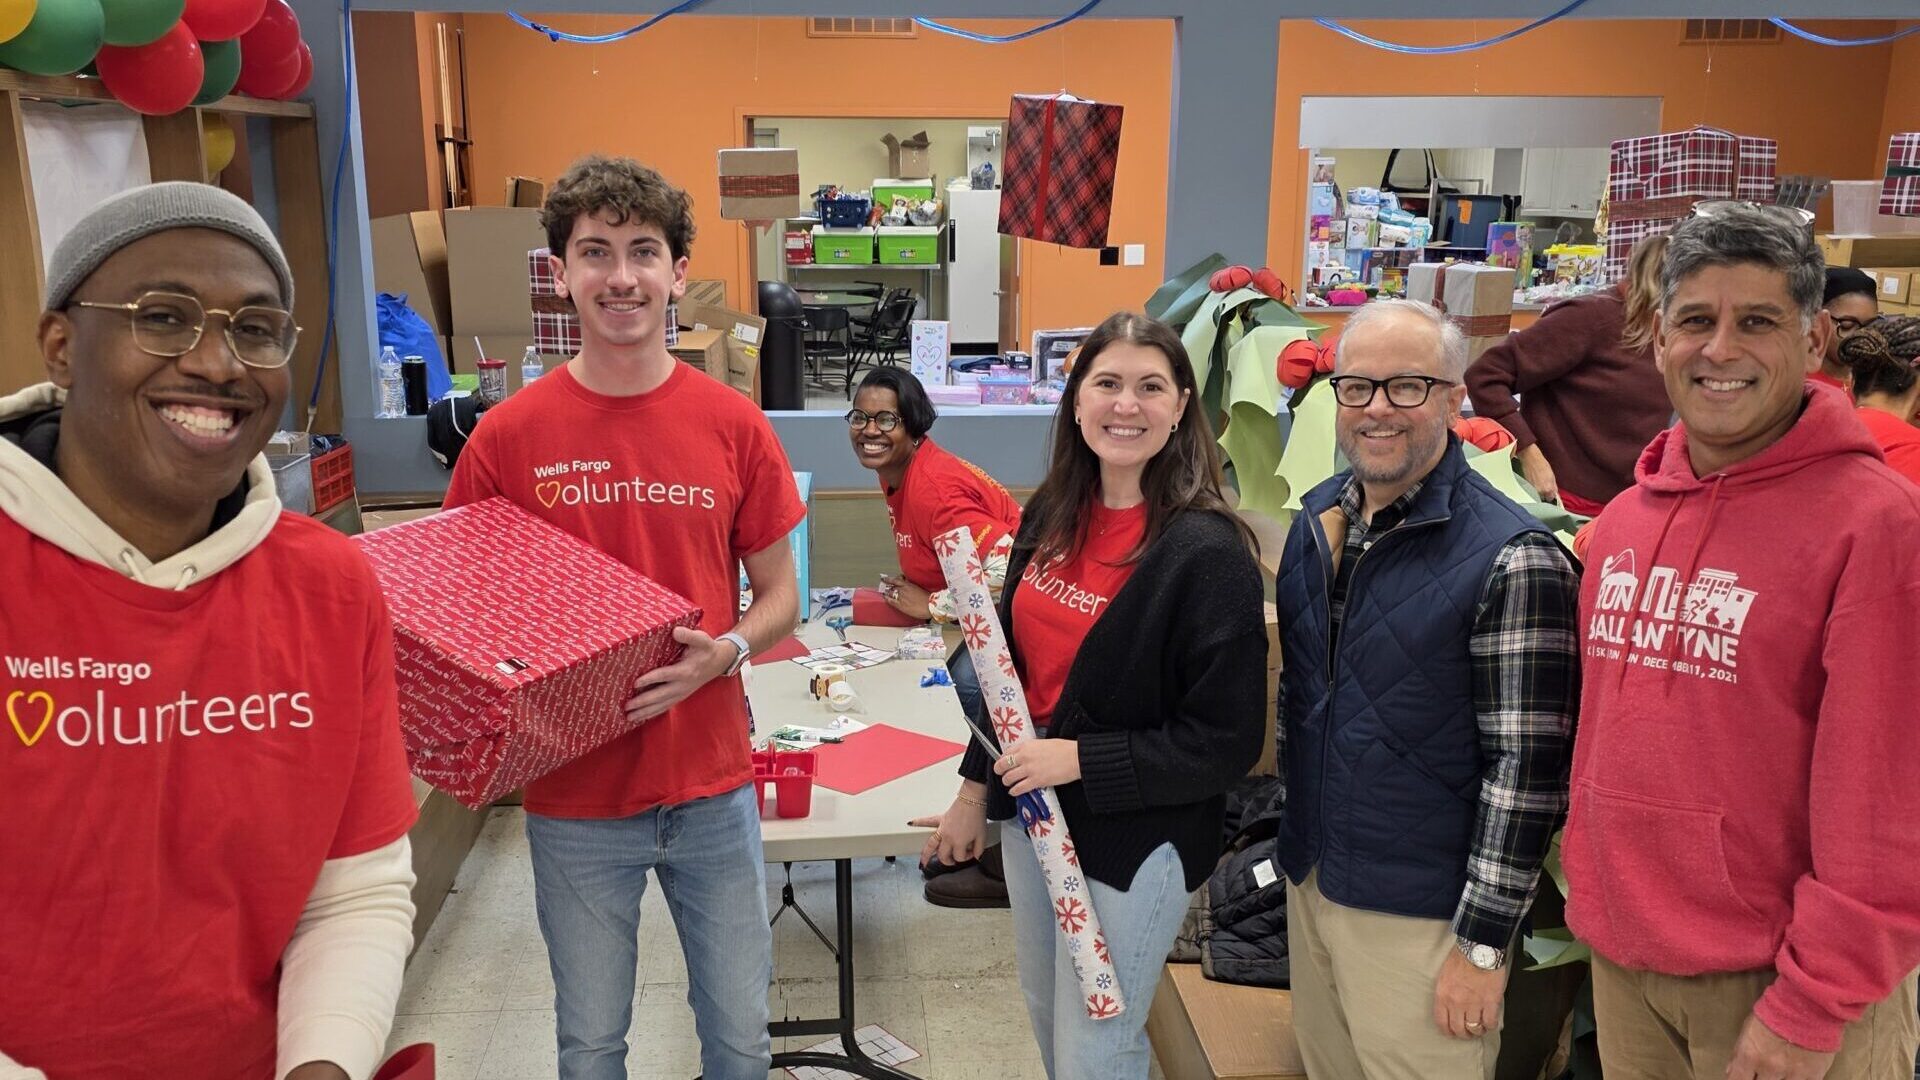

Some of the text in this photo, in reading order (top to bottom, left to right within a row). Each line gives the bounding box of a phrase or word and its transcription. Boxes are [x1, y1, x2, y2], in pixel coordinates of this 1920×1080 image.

[534, 460, 611, 479] Wells Fargo
[1022, 562, 1108, 616] olunteer
[5, 656, 151, 686] Wells Fargo
[1708, 667, 1738, 684] 2021
